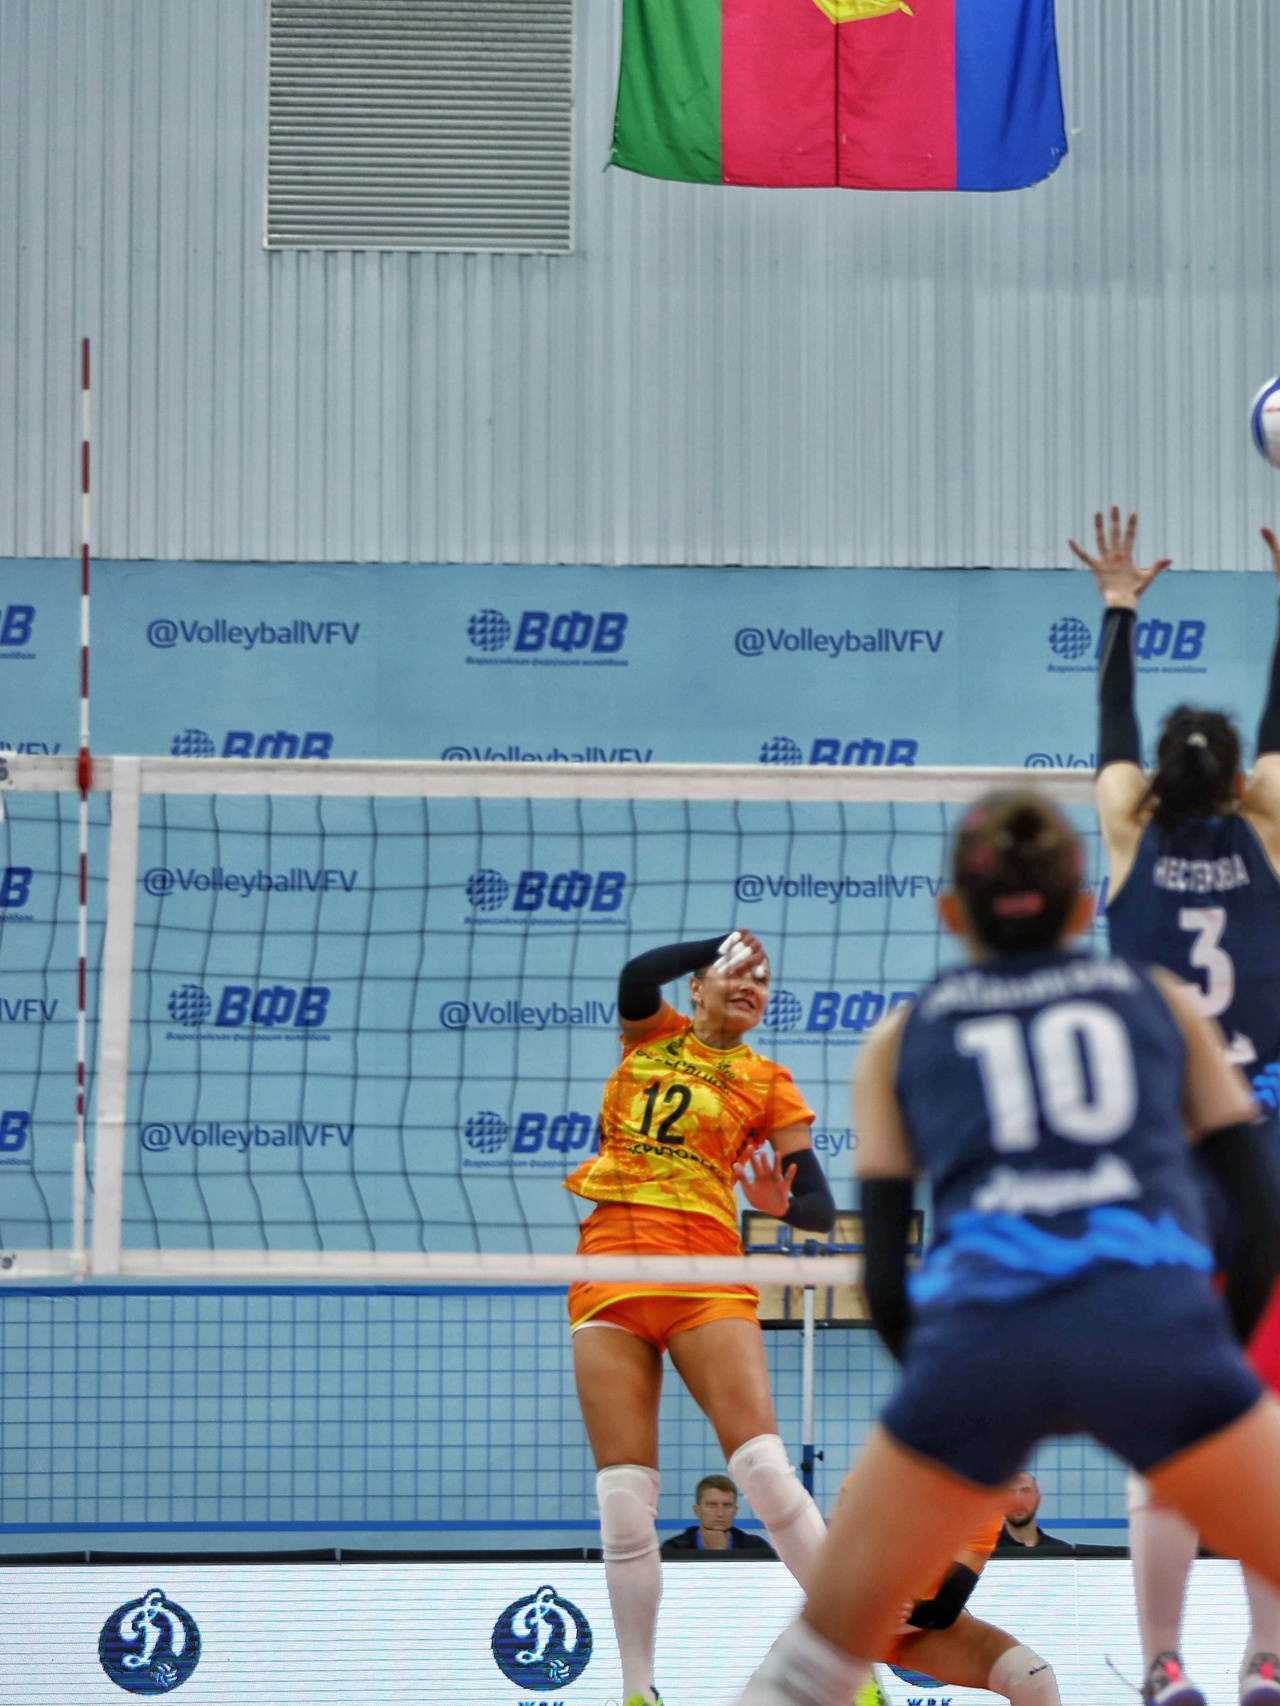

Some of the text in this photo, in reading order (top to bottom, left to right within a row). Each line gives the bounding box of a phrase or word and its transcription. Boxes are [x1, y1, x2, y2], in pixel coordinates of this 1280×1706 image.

[146, 619, 360, 650] @VolleyballVFV
[513, 610, 629, 653] ВФВ
[734, 627, 943, 659] @VolleyballVFV
[1094, 618, 1206, 660] ФВ
[221, 731, 334, 760] ВФВ
[809, 737, 919, 767] ВФВ
[144, 867, 358, 899] @VolleyballVFV
[512, 869, 627, 912] ВФВ
[734, 875, 943, 905] @VolleyballVFV
[1177, 906, 1236, 1018] 3
[214, 985, 331, 1028] ВФВ
[440, 1000, 619, 1032] @VolleyballV
[954, 999, 1139, 1153] 10
[641, 1081, 692, 1145] 12
[140, 1122, 354, 1153] @VolleyballVFV
[512, 1111, 601, 1154] ВФ
